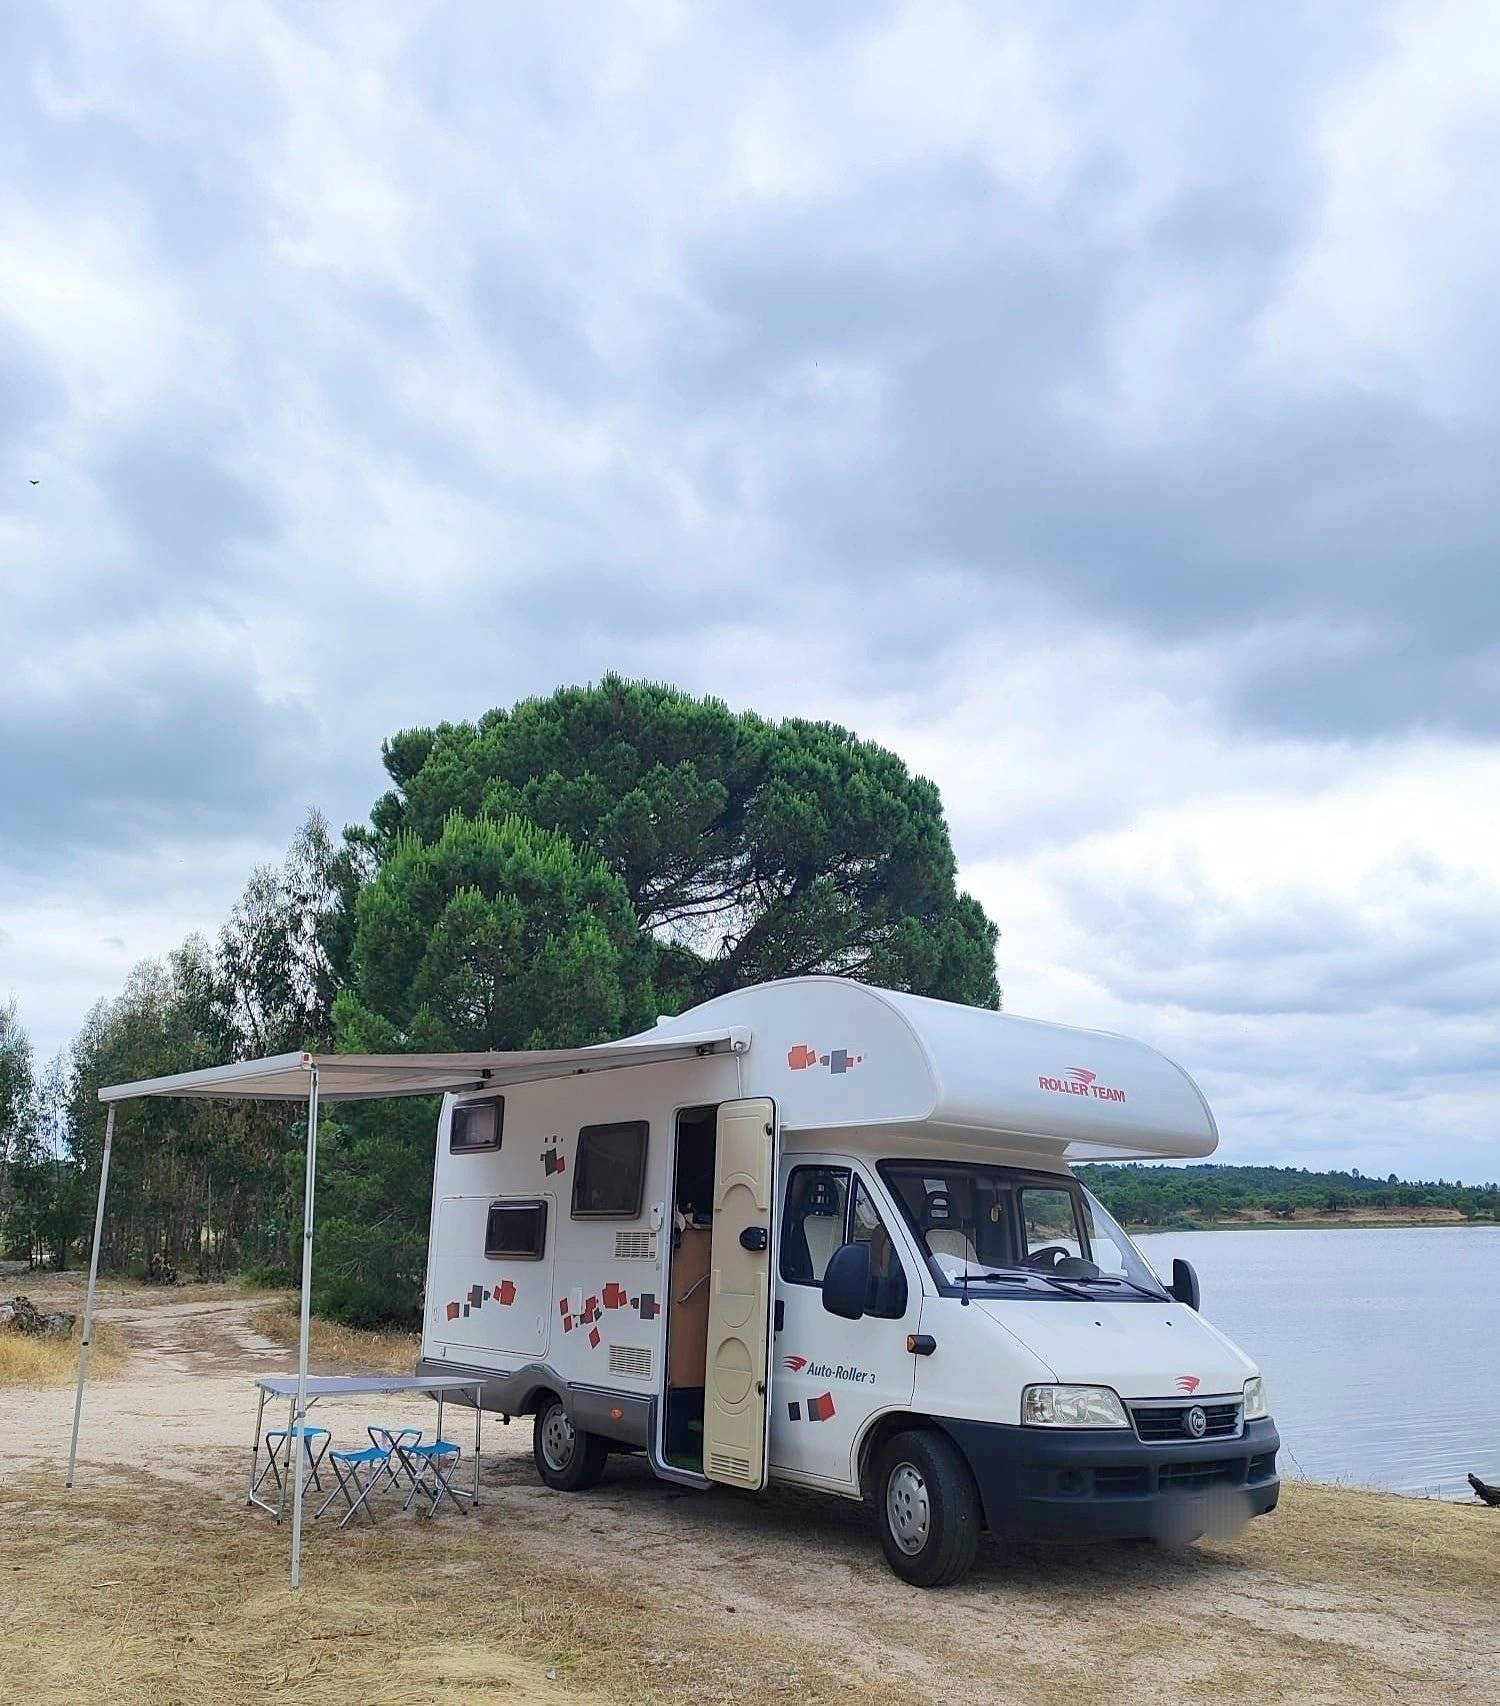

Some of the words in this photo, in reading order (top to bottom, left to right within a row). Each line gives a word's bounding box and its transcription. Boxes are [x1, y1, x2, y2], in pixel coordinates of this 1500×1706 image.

[1038, 1076, 1089, 1096] ROLLER
[1091, 1085, 1126, 1103] TEAM
[807, 1362, 867, 1382] Auto-Roller
[869, 1373, 876, 1384] 3
